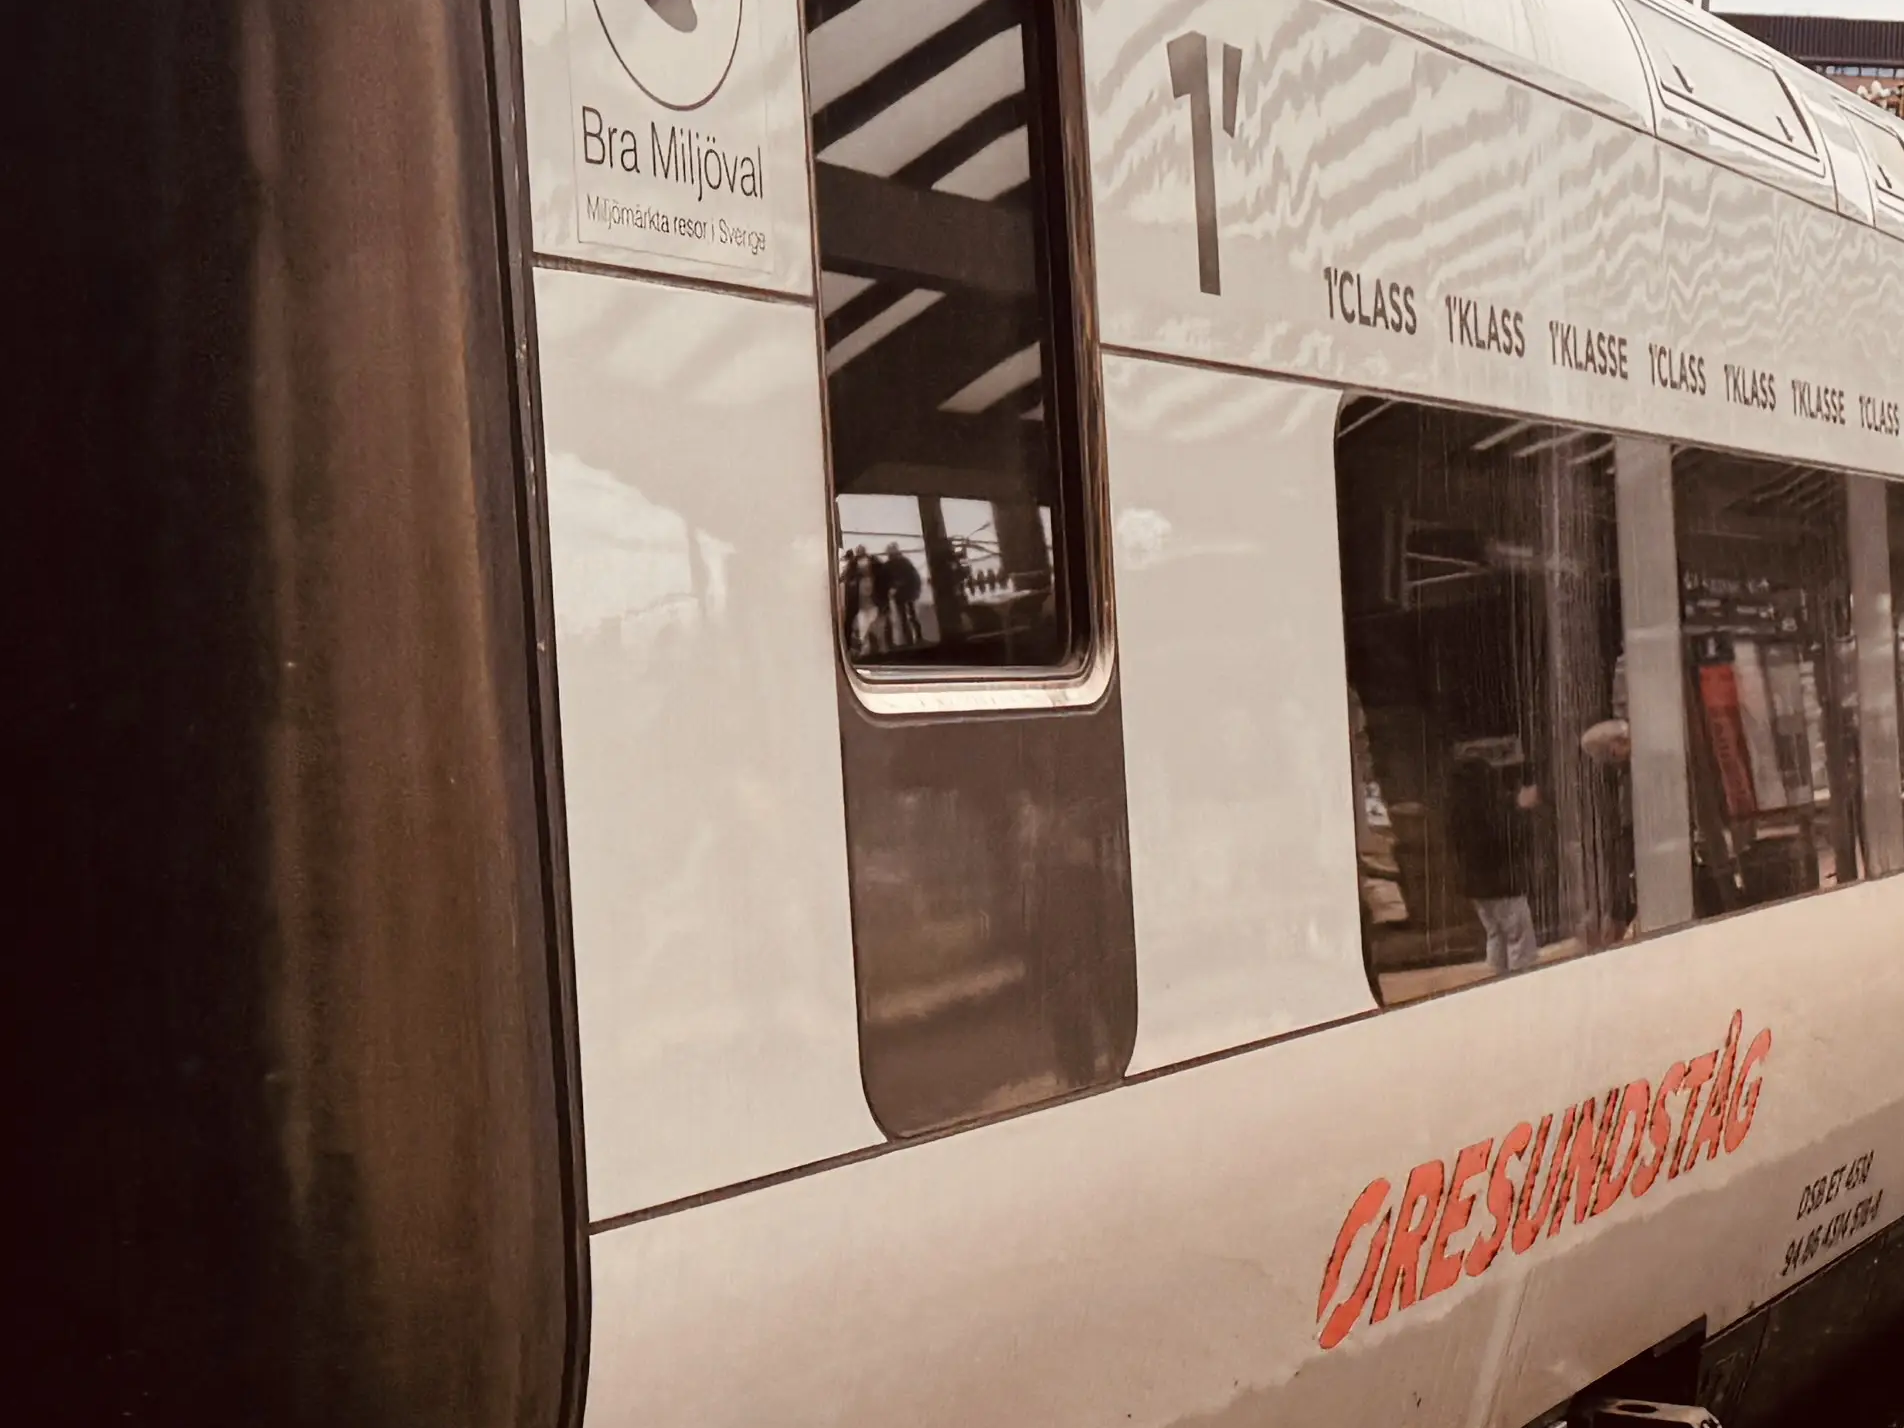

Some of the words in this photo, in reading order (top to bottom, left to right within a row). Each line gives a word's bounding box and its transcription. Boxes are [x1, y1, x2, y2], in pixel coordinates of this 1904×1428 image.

[581, 105, 641, 174] Bra
[650, 120, 764, 203] Miljöval
[673, 216, 707, 240] resor
